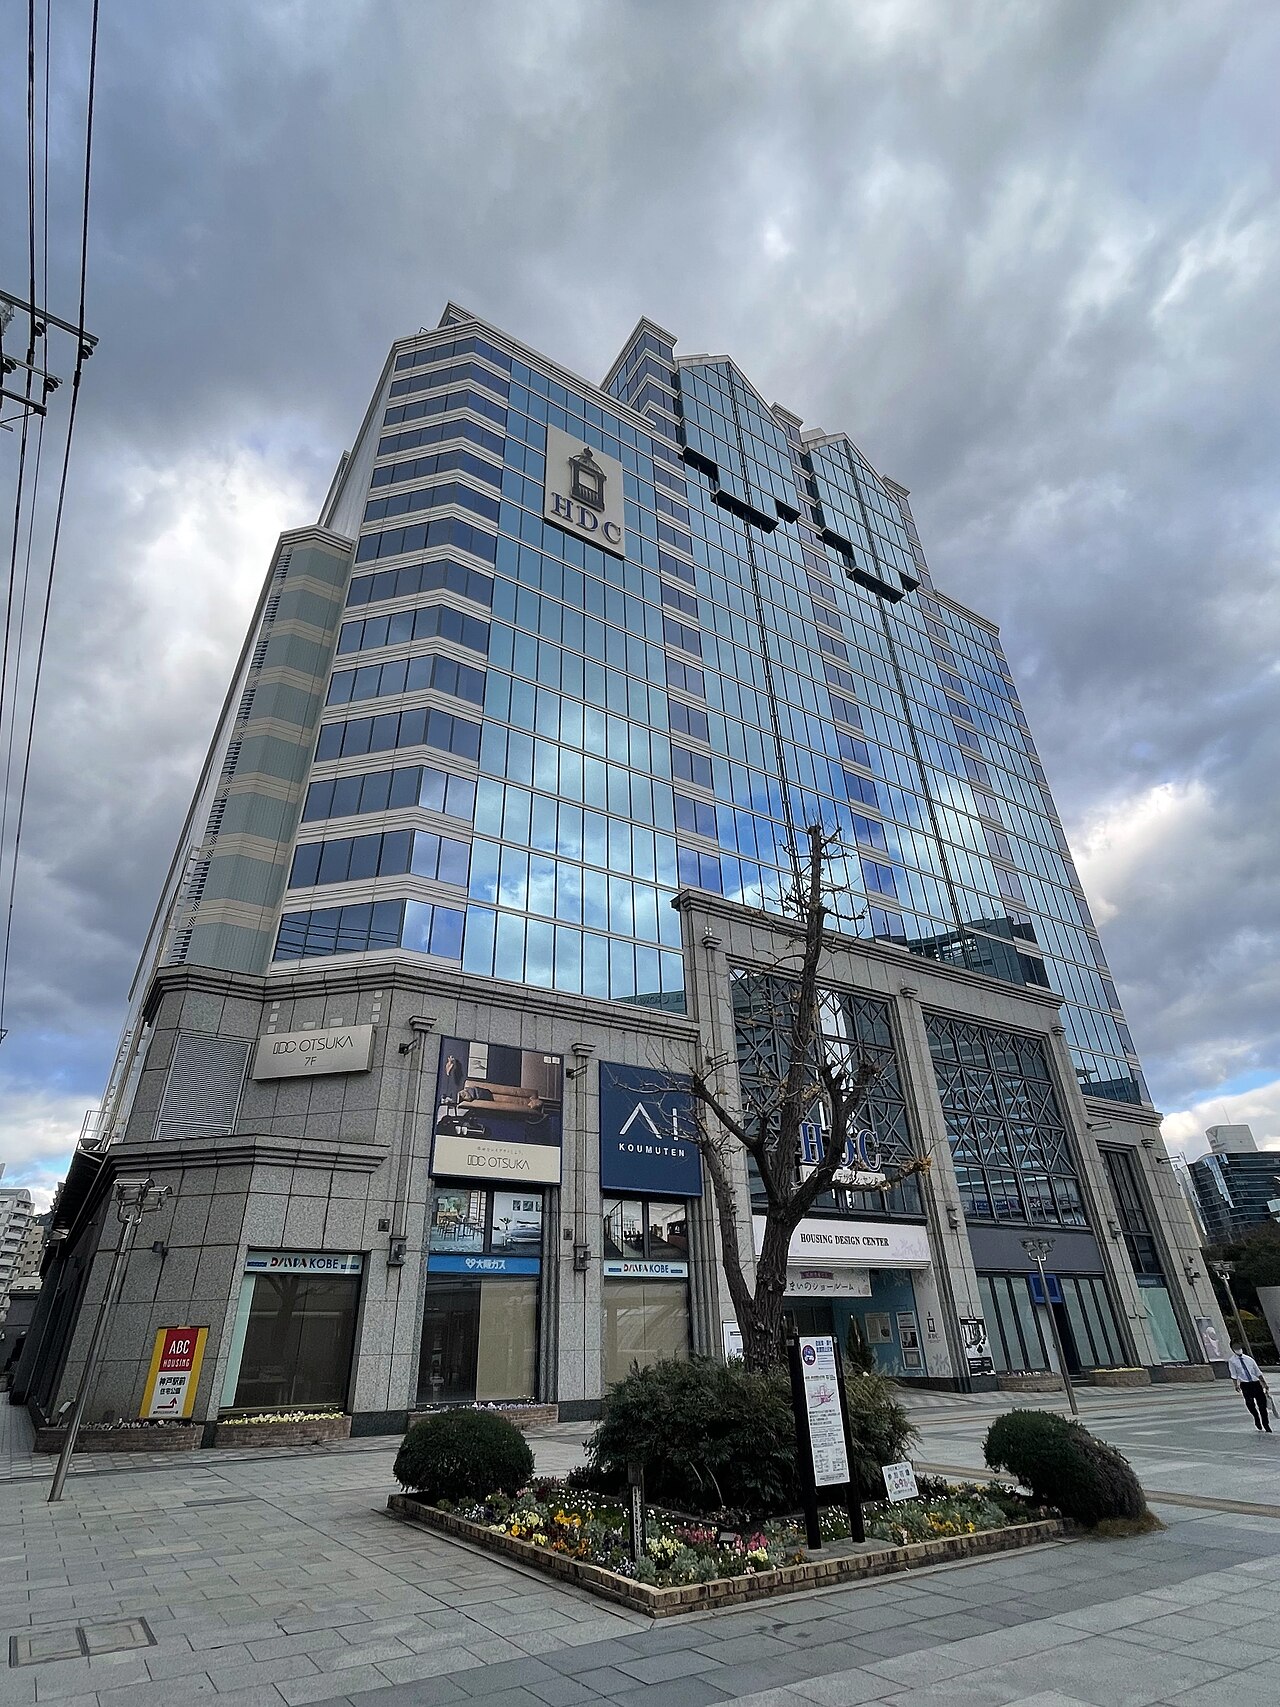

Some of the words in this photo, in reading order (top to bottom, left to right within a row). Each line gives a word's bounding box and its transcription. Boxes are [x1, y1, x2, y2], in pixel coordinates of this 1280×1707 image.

[551, 491, 621, 545] HDC
[273, 1041, 297, 1055] IDC
[299, 1035, 354, 1053] OTSUKA
[304, 1056, 317, 1066] 7F
[618, 1143, 685, 1157] KOUMUTEN
[488, 1156, 530, 1170] OTSUKA
[800, 1233, 833, 1244] HOUSING
[835, 1235, 860, 1246] DESIGN
[863, 1237, 889, 1247] CENTER
[309, 1258, 339, 1269] KOBE
[649, 1264, 669, 1273] KOBE
[787, 1281, 855, 1293] まいのショールーム
[168, 1339, 191, 1355] ABC
[162, 1358, 190, 1368] HOUSING
